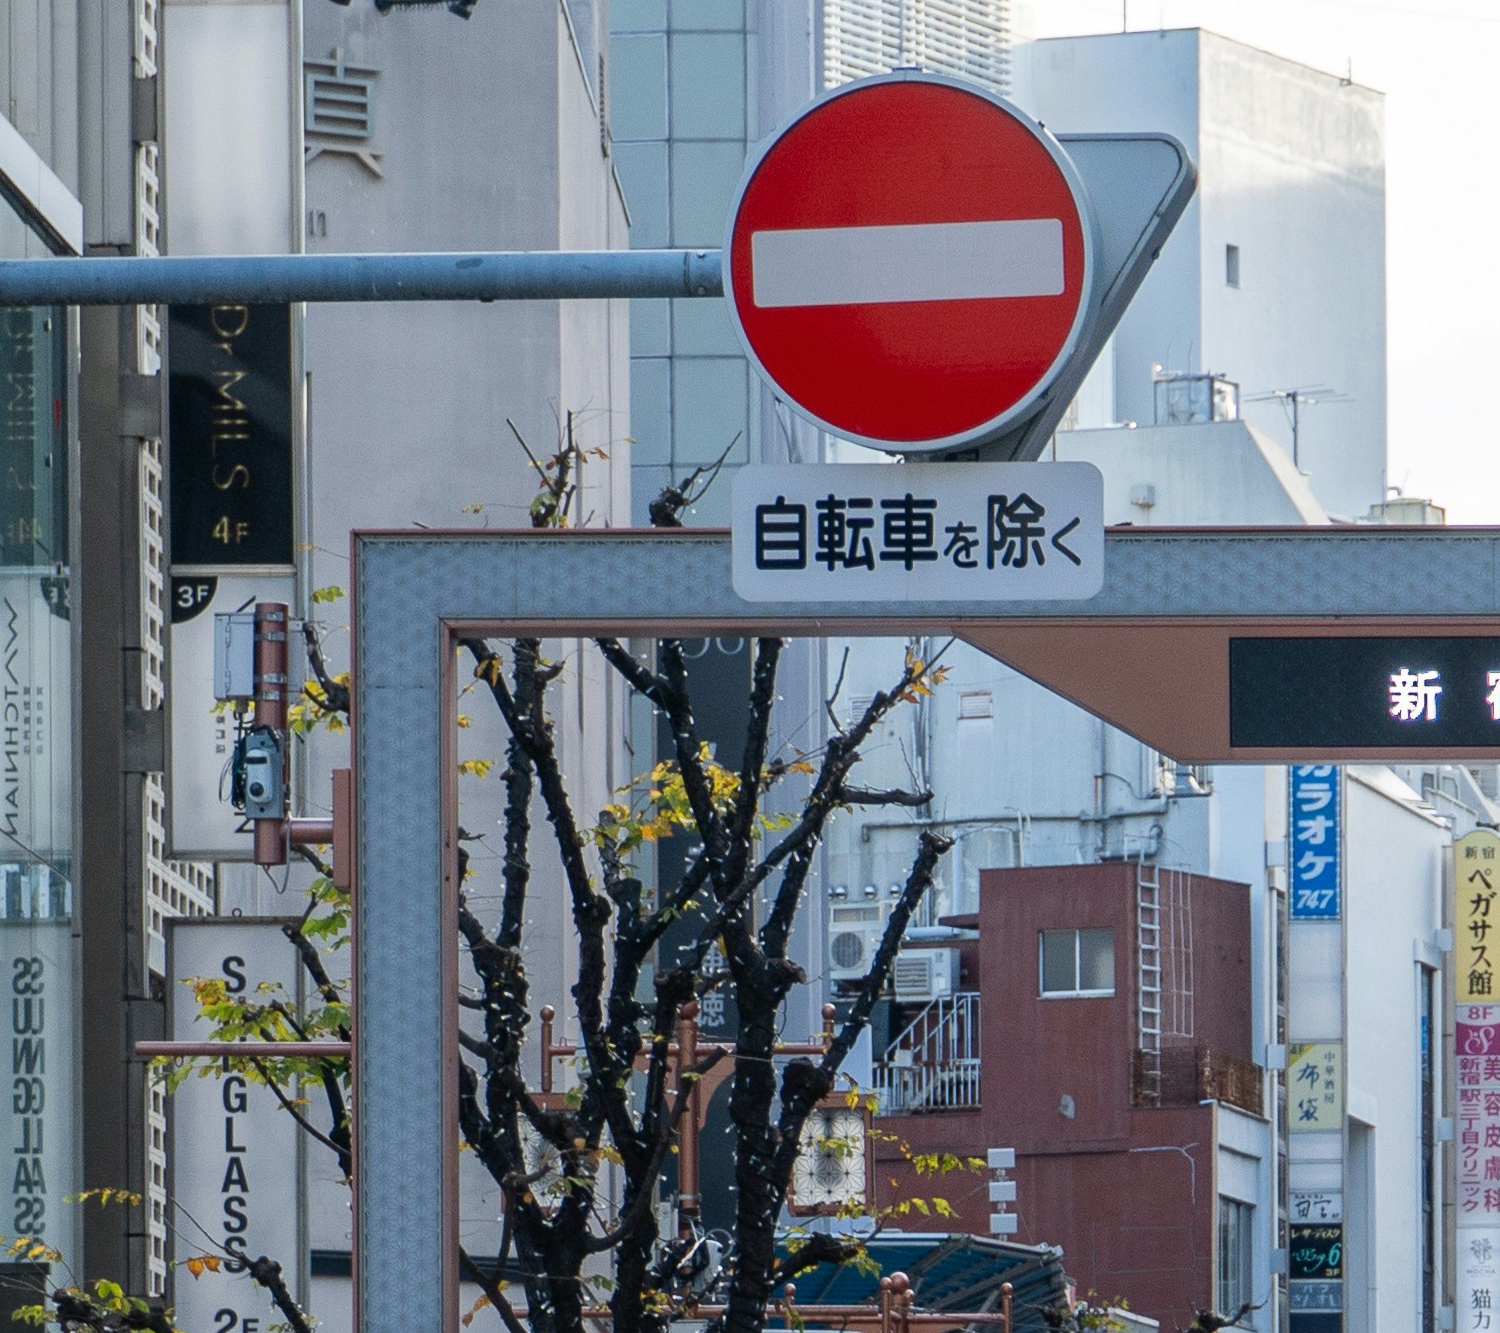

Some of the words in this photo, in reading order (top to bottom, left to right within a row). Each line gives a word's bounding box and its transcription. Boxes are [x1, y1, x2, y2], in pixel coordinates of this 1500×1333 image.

[211, 515, 250, 545] 4F
[753, 493, 1083, 571] 自転車を除く
[177, 585, 210, 608] 3F
[1296, 889, 1334, 909] 747
[1466, 867, 1498, 997] ペガサス館
[1466, 1006, 1495, 1021] 8F
[221, 955, 250, 1275] SGLASS
